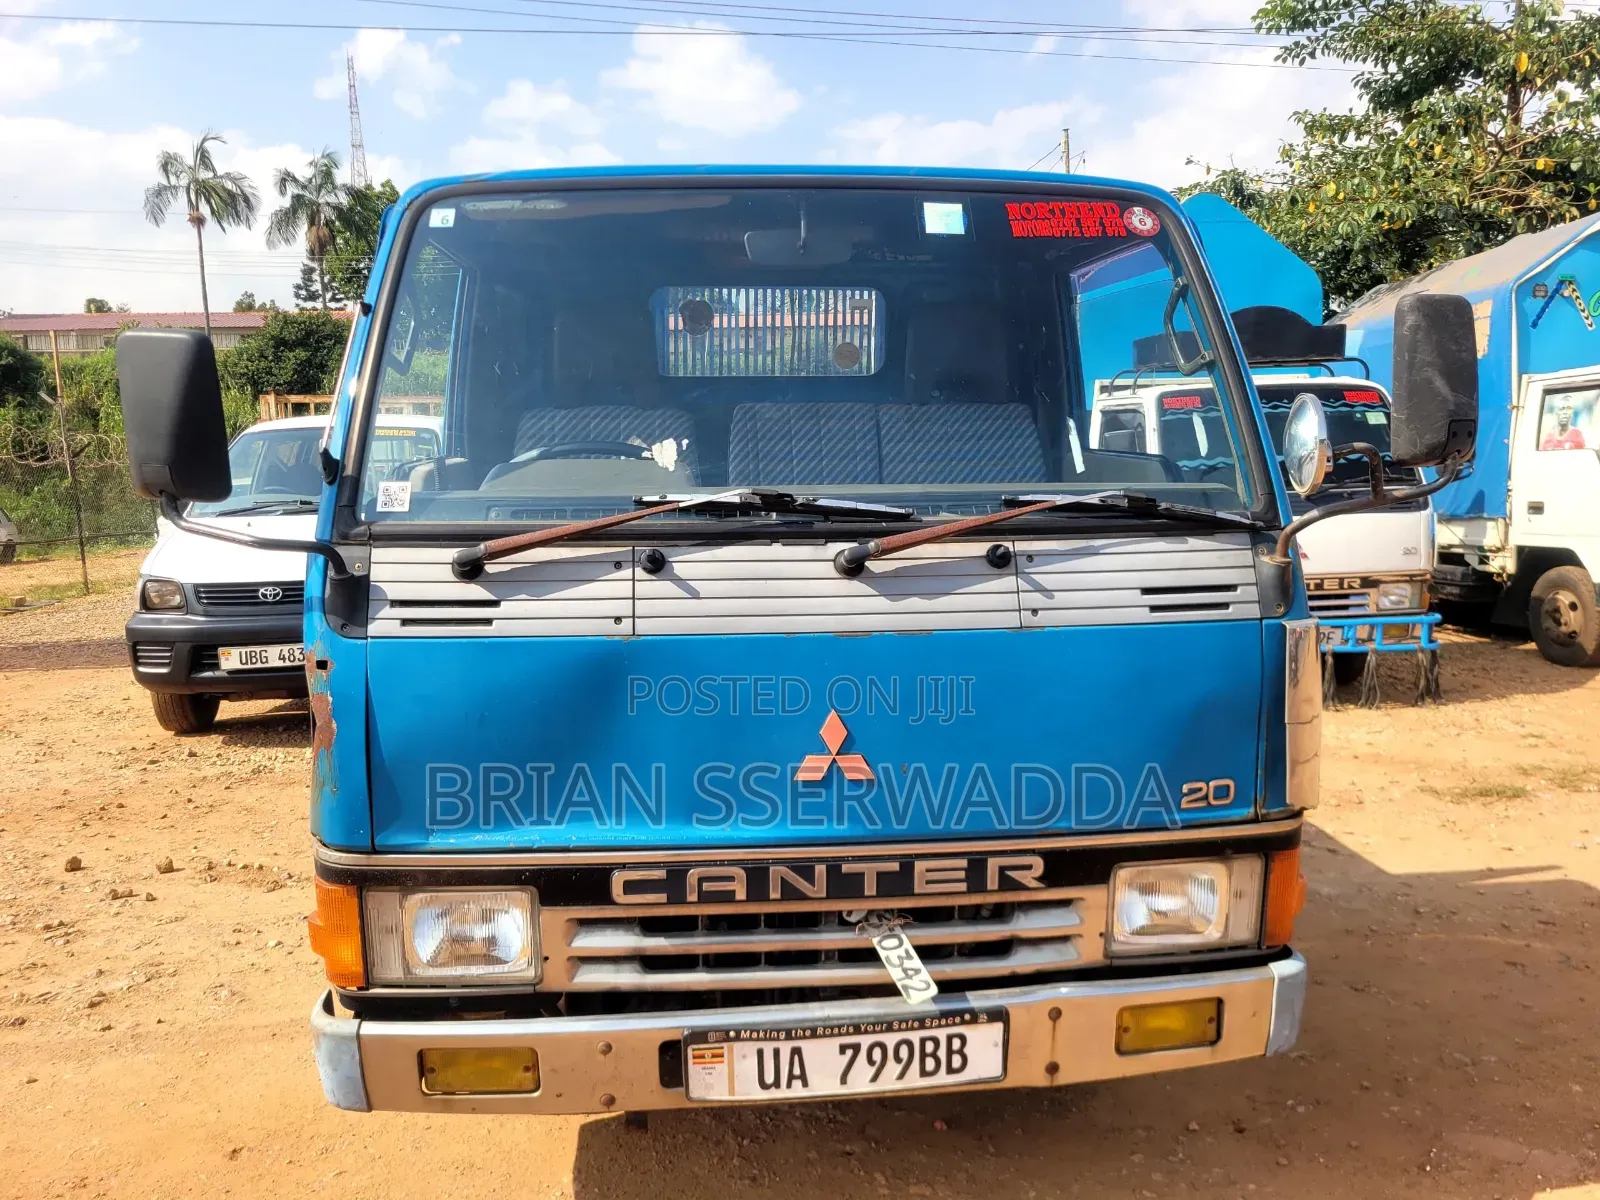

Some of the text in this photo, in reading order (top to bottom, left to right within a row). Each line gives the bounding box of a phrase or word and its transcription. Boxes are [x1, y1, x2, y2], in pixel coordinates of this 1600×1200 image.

[1005, 202, 1120, 219] NORTHEND
[1305, 578, 1361, 590] TER
[239, 647, 306, 666] UBG 483
[1180, 778, 1235, 809] 20
[610, 855, 1046, 905] CANTER
[876, 933, 932, 1001] 0342
[740, 1016, 961, 1040] Making the Roads Your Safe Space
[756, 1032, 968, 1090] UA 799BB
